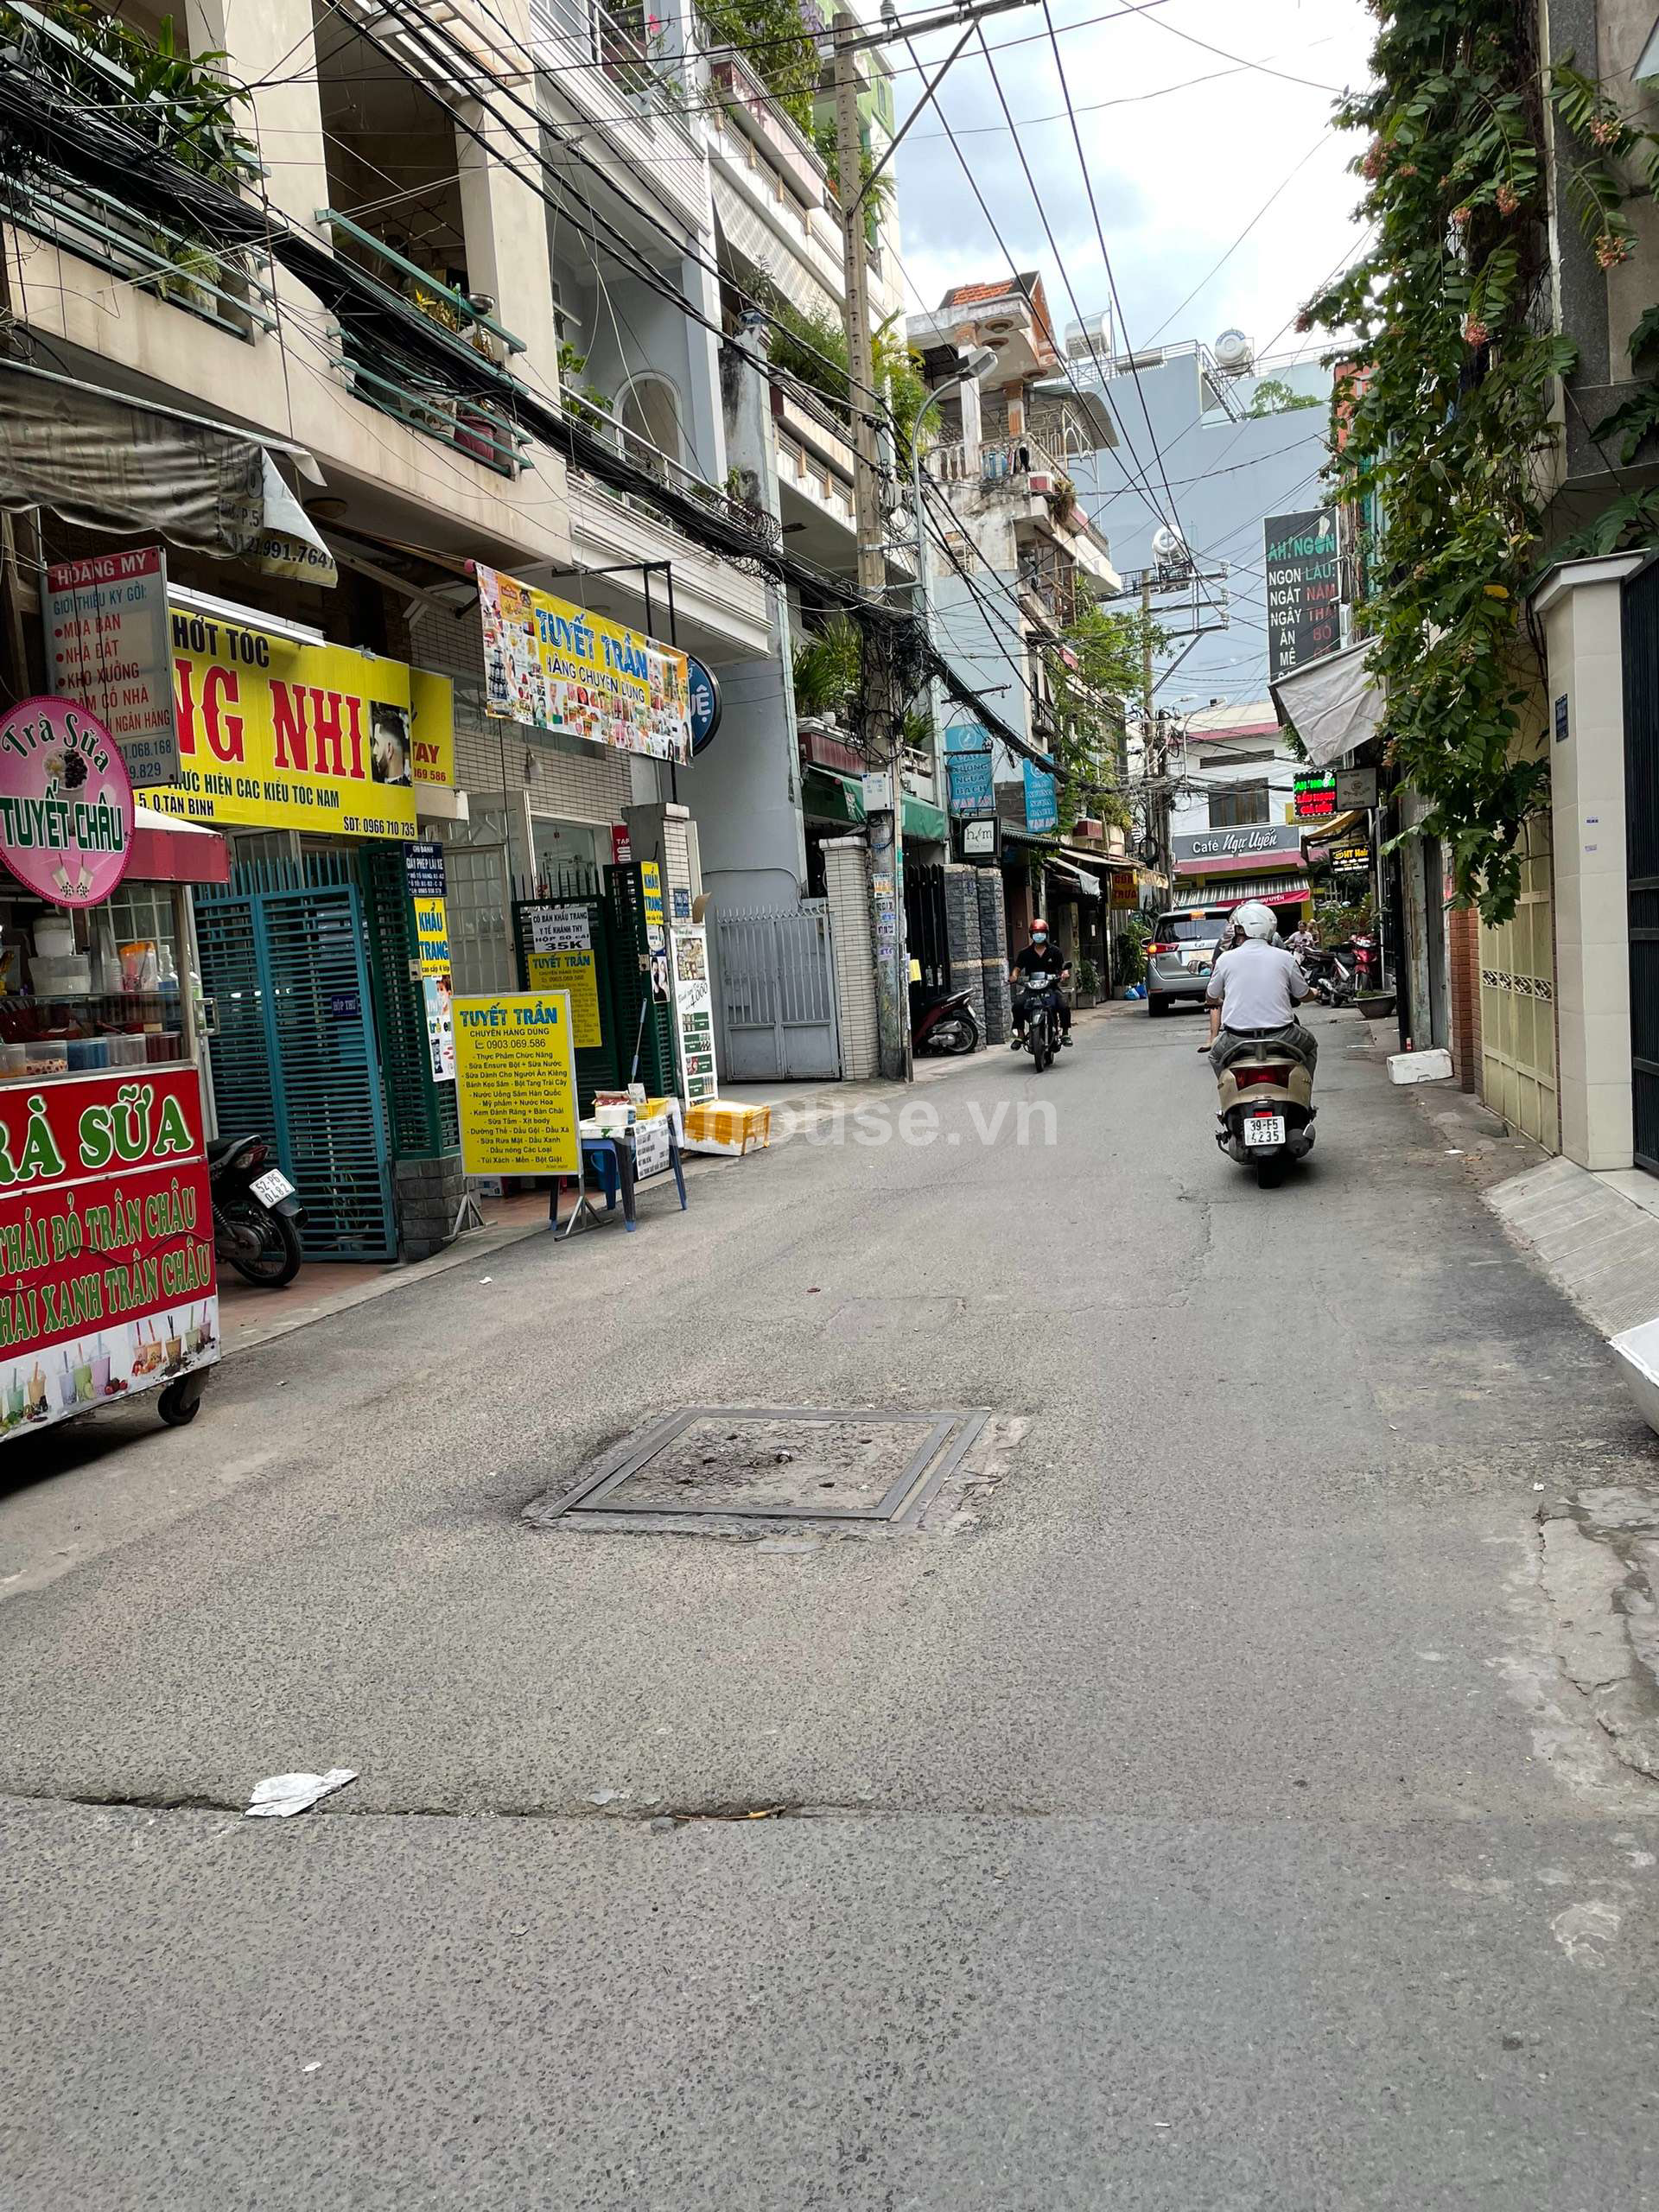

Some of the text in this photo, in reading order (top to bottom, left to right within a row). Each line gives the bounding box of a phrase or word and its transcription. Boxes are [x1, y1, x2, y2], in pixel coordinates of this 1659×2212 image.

[57, 562, 115, 586] HOÀNG
[1268, 568, 1301, 587] NGON
[64, 620, 91, 639] MUA
[1280, 627, 1295, 646] ĂN
[226, 628, 270, 668] TÓC
[535, 608, 648, 681] TUYẾT TRẦN
[1280, 646, 1296, 667] MÊ
[67, 670, 92, 690] KHO
[124, 684, 149, 706] NHÀ
[269, 679, 366, 779] NHI
[2, 711, 111, 774] Trà Sữa
[430, 770, 446, 781] 586
[204, 772, 232, 798] HIỆN
[292, 784, 313, 804] TÓC
[316, 788, 340, 808] NAM
[0, 778, 124, 853] TUYẾT CHÂU
[363, 818, 415, 836] 0966 710 735
[1192, 828, 1278, 854] Café Ngự Uyển
[419, 940, 449, 961] TRANG
[545, 940, 582, 950] 35K
[460, 1002, 507, 1027] TUYẾT
[513, 1001, 557, 1025] TRẦN
[470, 1028, 501, 1038] CHUYÊN
[486, 1039, 546, 1049] 0903.069.586
[79, 1082, 194, 1168] SỮA
[51, 1192, 83, 1262] ĐỎ
[86, 1188, 142, 1254] TRÂN
[145, 1177, 197, 1239] CHÂU
[41, 1235, 211, 1334] XANH TRÂN CHÂU
